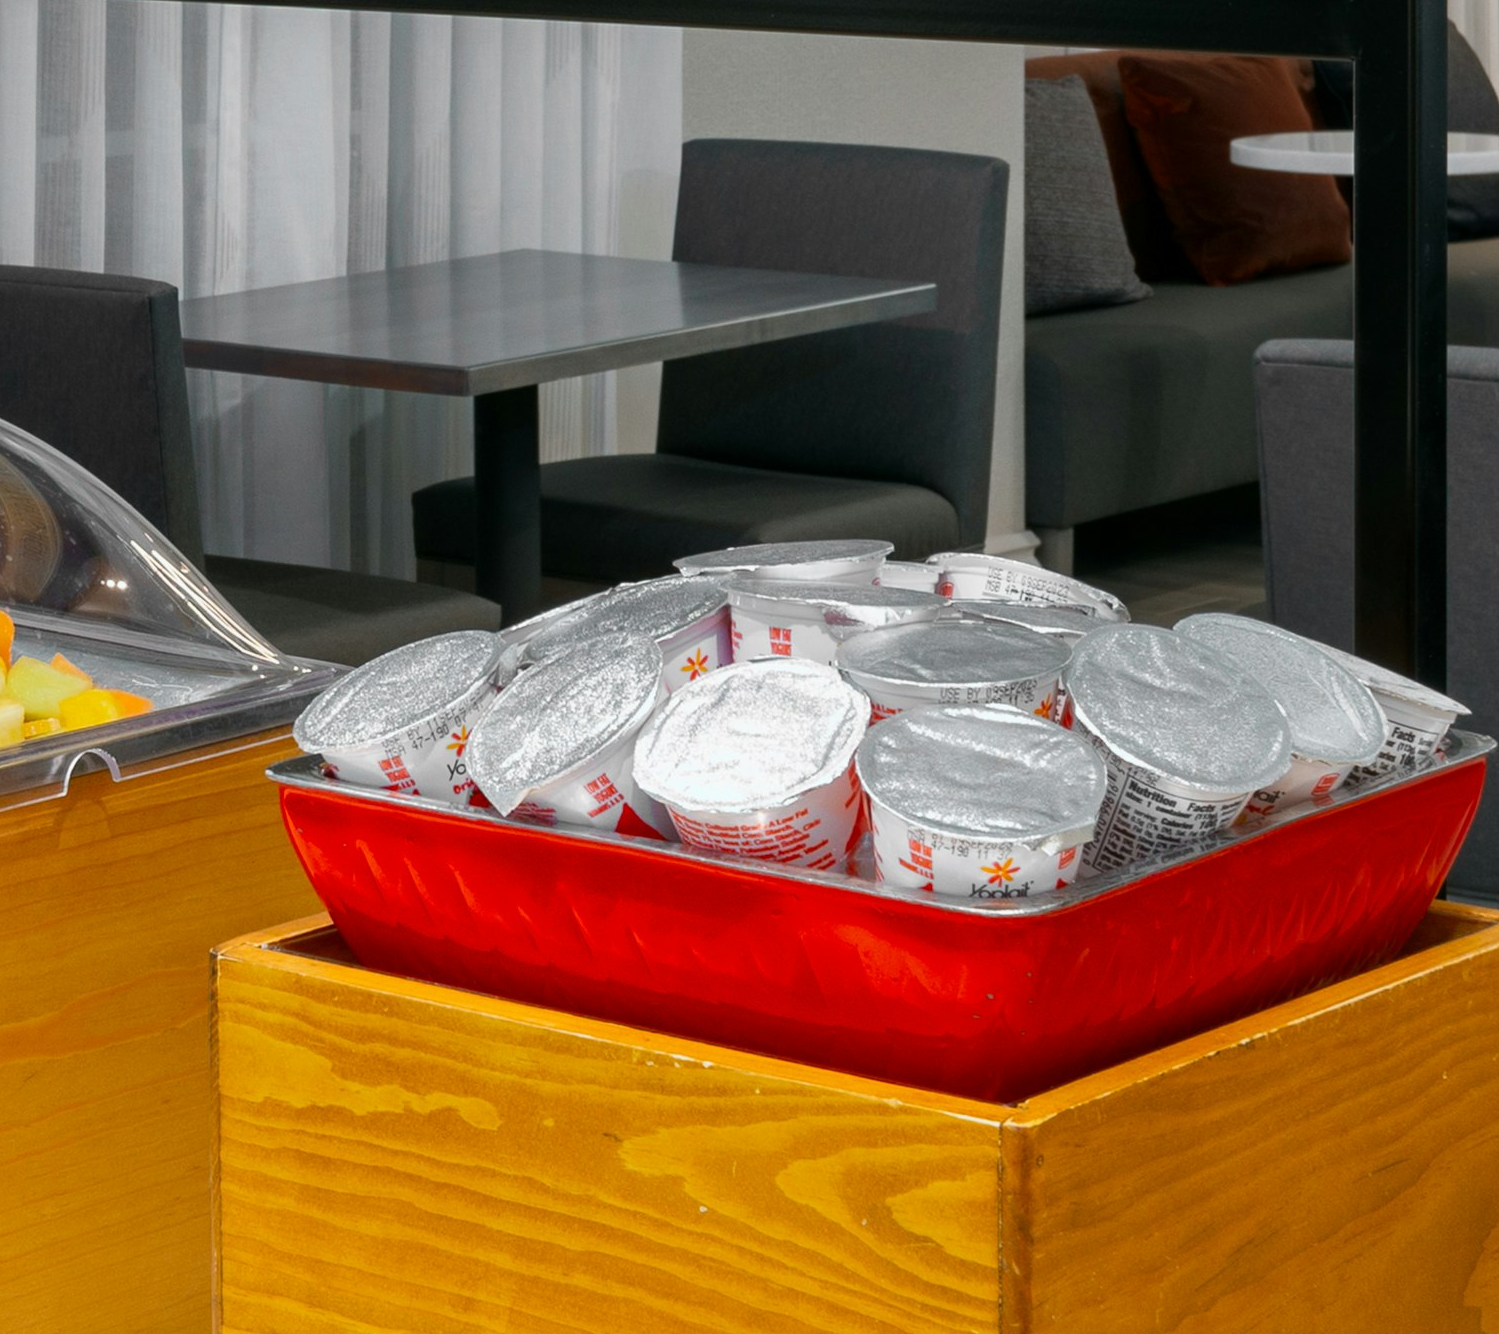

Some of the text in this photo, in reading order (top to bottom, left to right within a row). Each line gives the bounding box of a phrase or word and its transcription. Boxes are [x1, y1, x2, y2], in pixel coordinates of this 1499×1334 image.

[940, 687, 961, 701] USE
[967, 687, 981, 701] BY
[1129, 780, 1216, 813] Nutrition Facts
[1160, 818, 1194, 830] Calories
